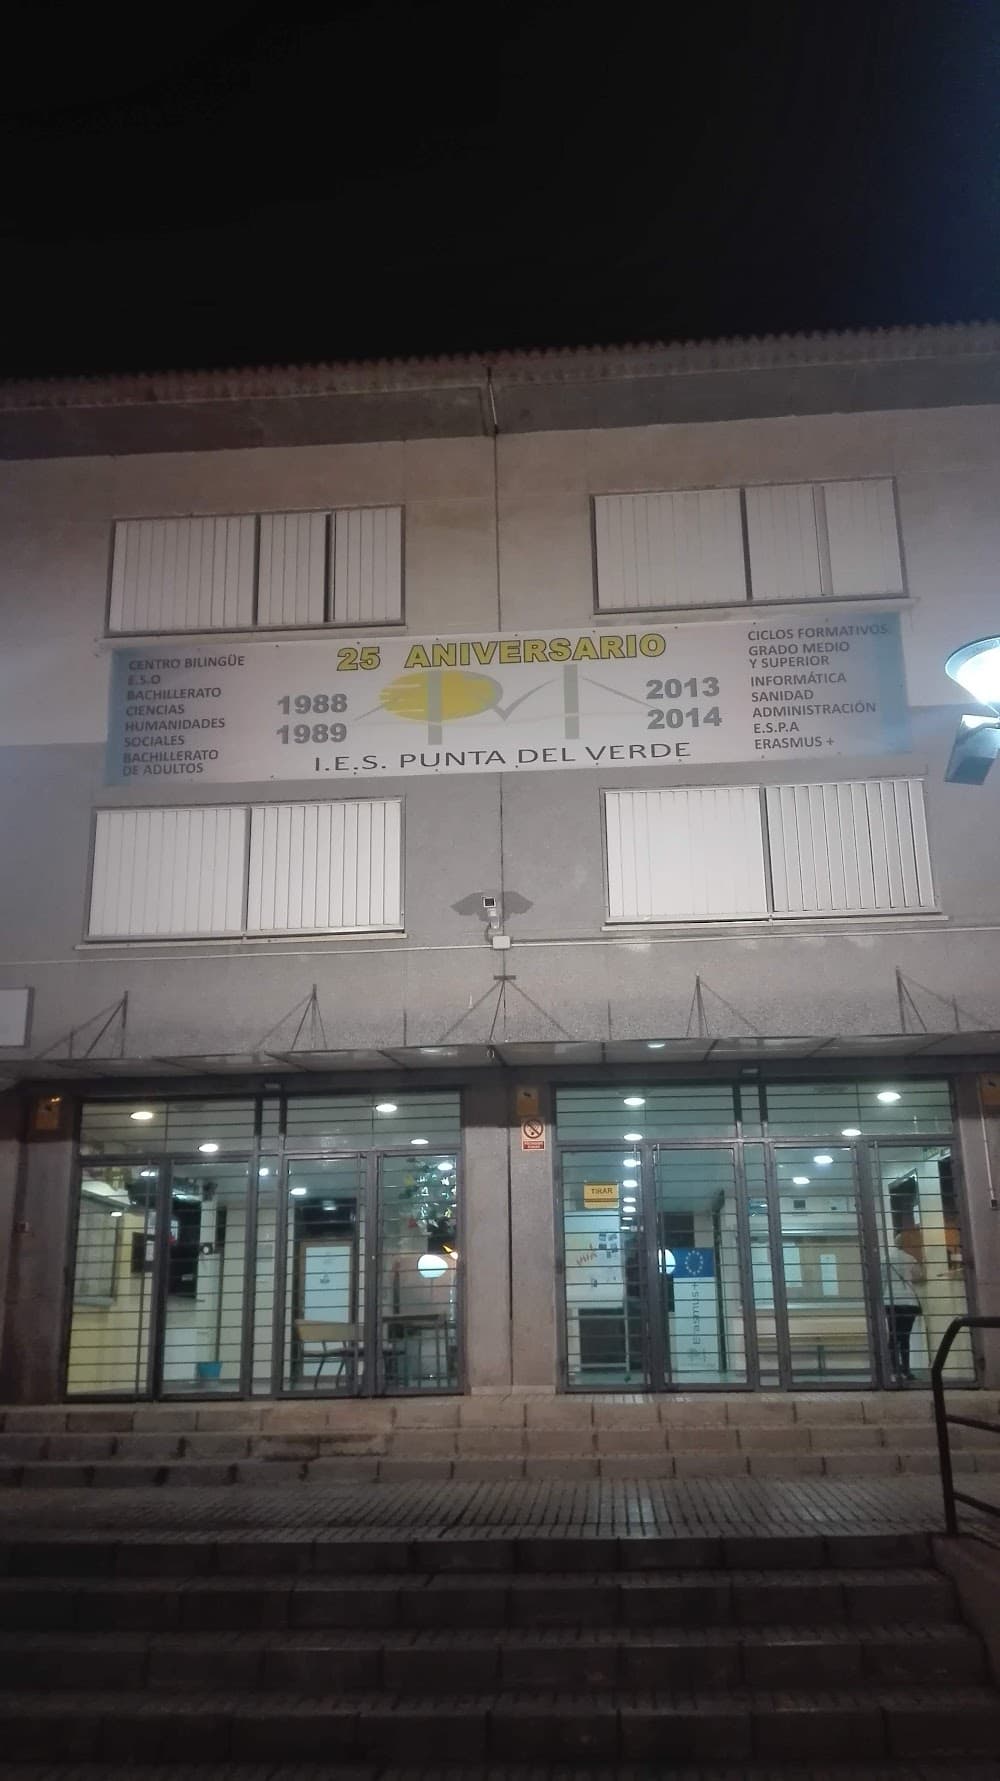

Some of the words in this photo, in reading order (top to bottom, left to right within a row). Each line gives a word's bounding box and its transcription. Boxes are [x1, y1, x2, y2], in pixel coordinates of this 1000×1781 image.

[748, 628, 794, 640] CICLOS
[798, 623, 889, 638] FORMATIVOS
[336, 646, 381, 671] 25
[404, 633, 666, 669] ANIVERSARIO
[748, 644, 799, 656] GRADO
[803, 641, 850, 654] MEDIO
[128, 659, 181, 670] CENTRO
[184, 654, 246, 668] BILINGÜE
[749, 658, 757, 669] Y
[761, 655, 830, 668] SUPERIOR
[750, 671, 848, 687] INFORMÁTICA
[127, 687, 222, 701] BACHILLERATO
[645, 676, 720, 700] 2013
[751, 689, 815, 702] SANIDAD
[126, 704, 185, 717] CIENCIAS
[277, 693, 348, 715] 1988
[752, 700, 877, 718] ADMINISTRACIÓN
[125, 718, 226, 732] HUMANIDADES
[647, 706, 722, 730] 2014
[276, 723, 347, 744] 1989
[753, 721, 800, 734] E.S.P.A
[124, 735, 185, 747] SOCIALES
[754, 736, 823, 750] ERASMUS
[123, 749, 219, 763] BACHILLERATO
[315, 755, 386, 772] I.E.S.
[400, 750, 506, 769] PUNTA
[518, 747, 576, 764] DEL
[585, 742, 692, 761] VERDE
[122, 765, 139, 777] DE
[143, 762, 204, 775] ADULTOS
[591, 1187, 613, 1195] TIRAR
